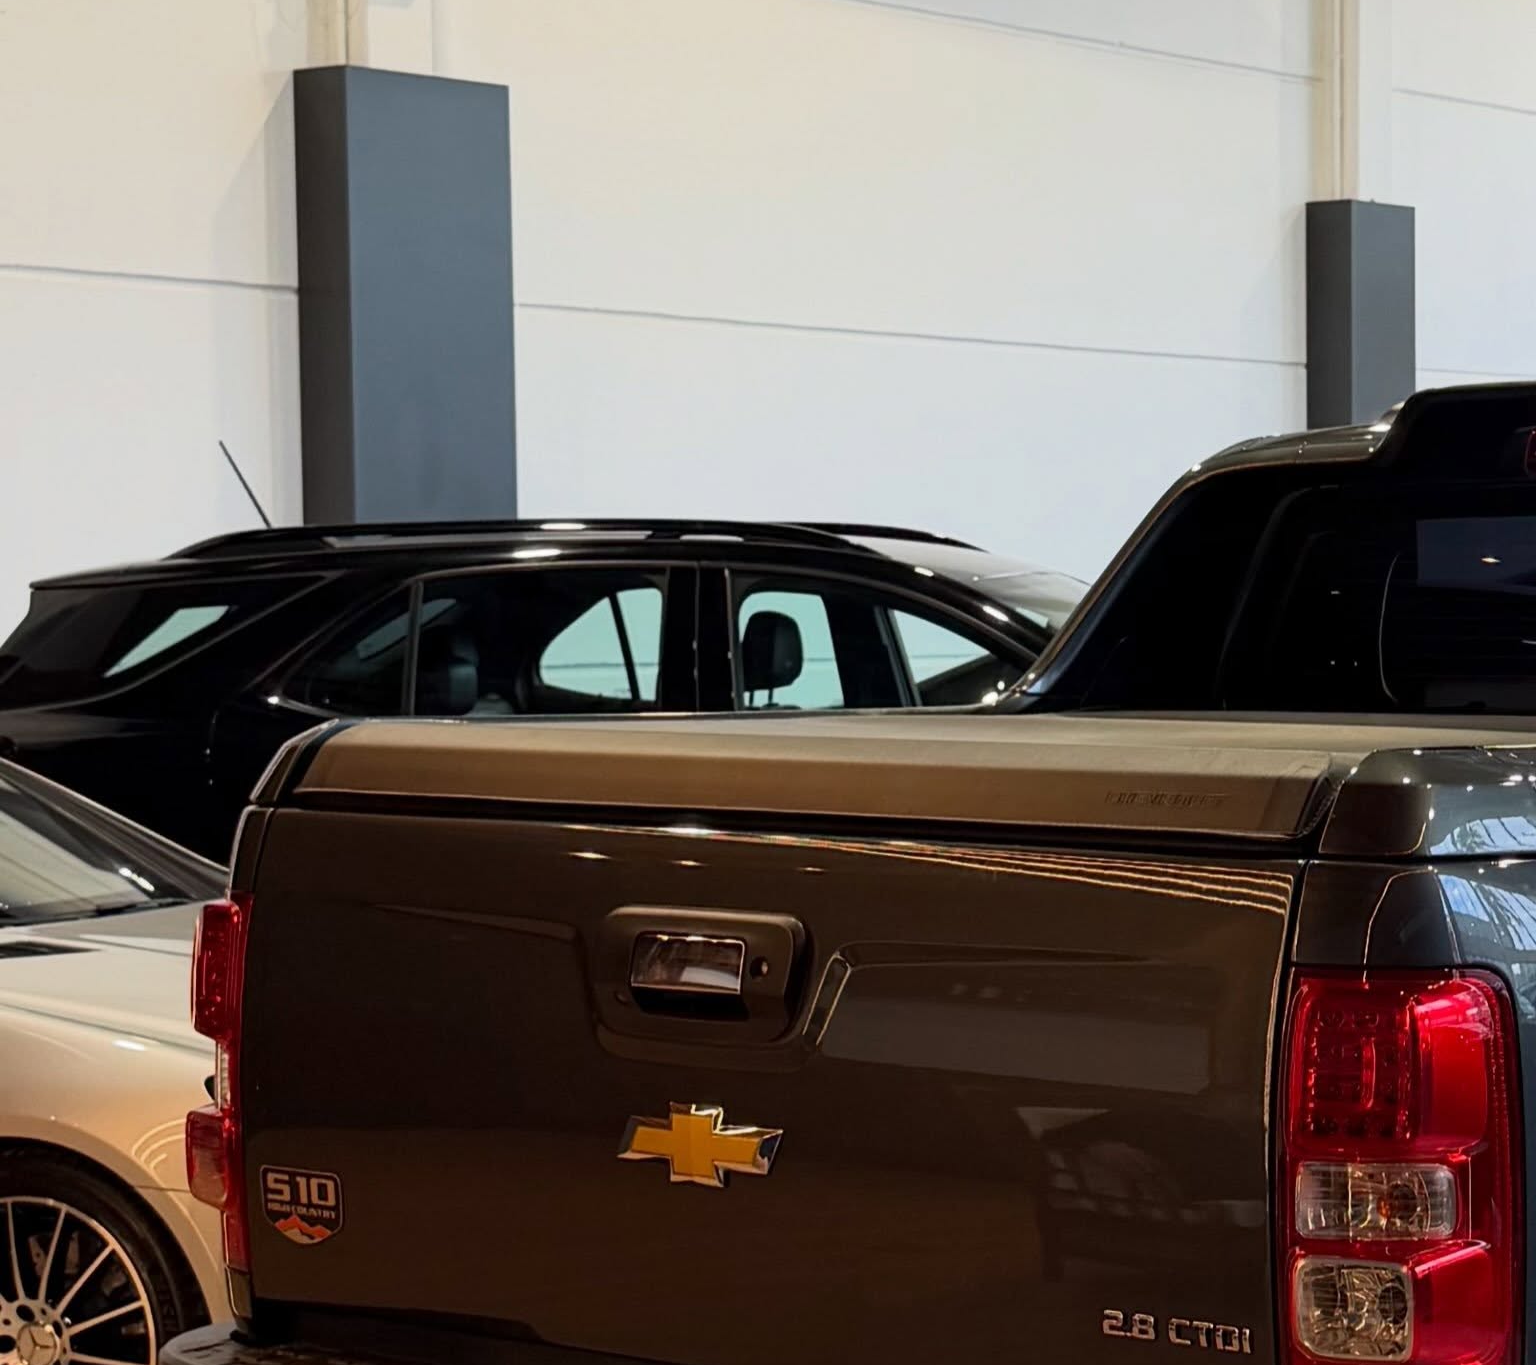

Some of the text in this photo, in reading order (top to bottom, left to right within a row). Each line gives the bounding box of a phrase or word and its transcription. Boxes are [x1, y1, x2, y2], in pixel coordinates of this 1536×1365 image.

[266, 1172, 337, 1208] S10
[1102, 1308, 1252, 1355] 2.8 CTDI
